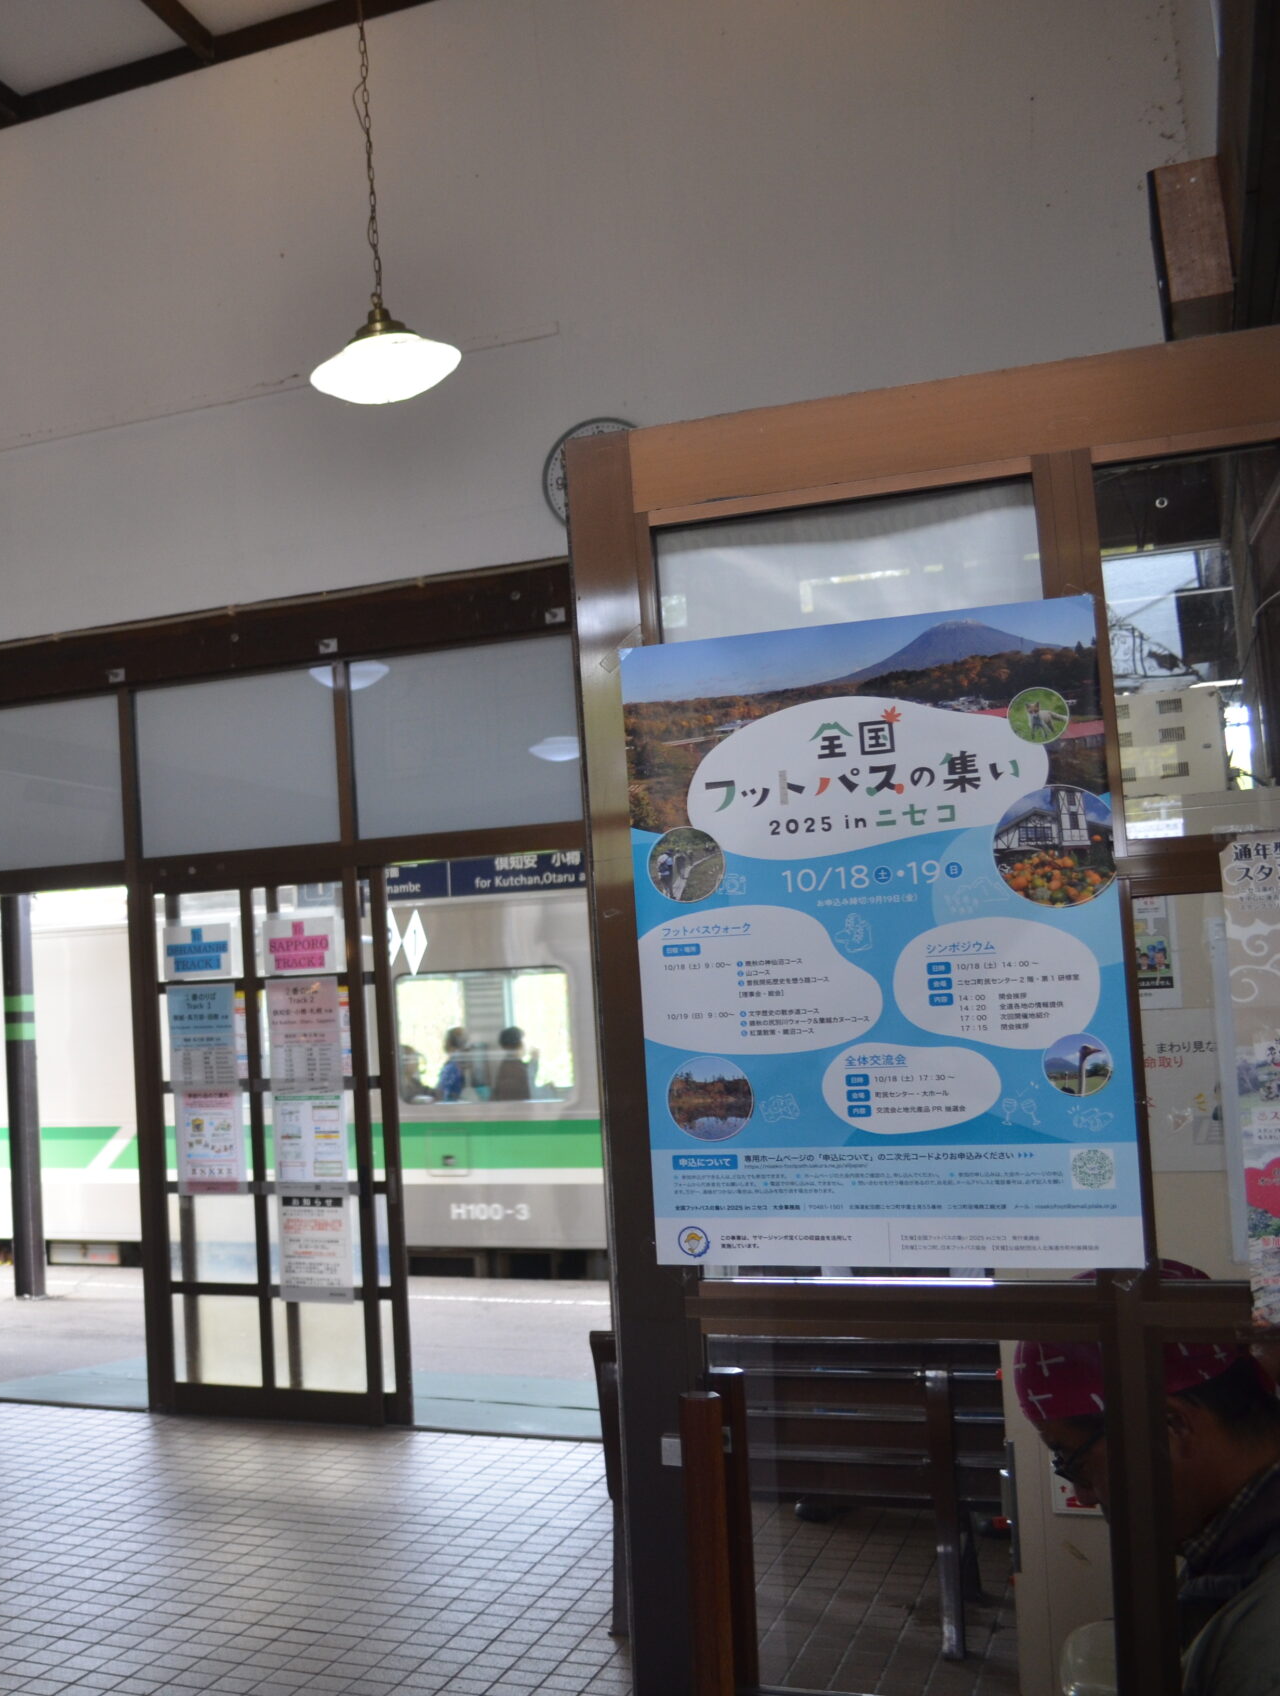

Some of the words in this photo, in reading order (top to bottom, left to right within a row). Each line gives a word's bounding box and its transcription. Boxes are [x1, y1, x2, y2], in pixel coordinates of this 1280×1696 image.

[809, 720, 897, 760] 全国
[704, 750, 1019, 813] フットパスの集い
[768, 816, 833, 837] 2025
[844, 813, 868, 831] in
[875, 803, 957, 828] ニセコ
[494, 853, 538, 871] 倶知安
[551, 851, 581, 867] 小樽
[475, 877, 491, 889] for
[662, 923, 751, 938] フットパスウォーク
[269, 937, 328, 954] SAPPORO
[925, 941, 996, 954] シンポジウム
[175, 958, 214, 970] TRACK
[276, 954, 316, 969] TRACK
[844, 1054, 907, 1067] 全体交流会
[679, 1157, 731, 1168] 申込について
[450, 1203, 531, 1220] H100-3
